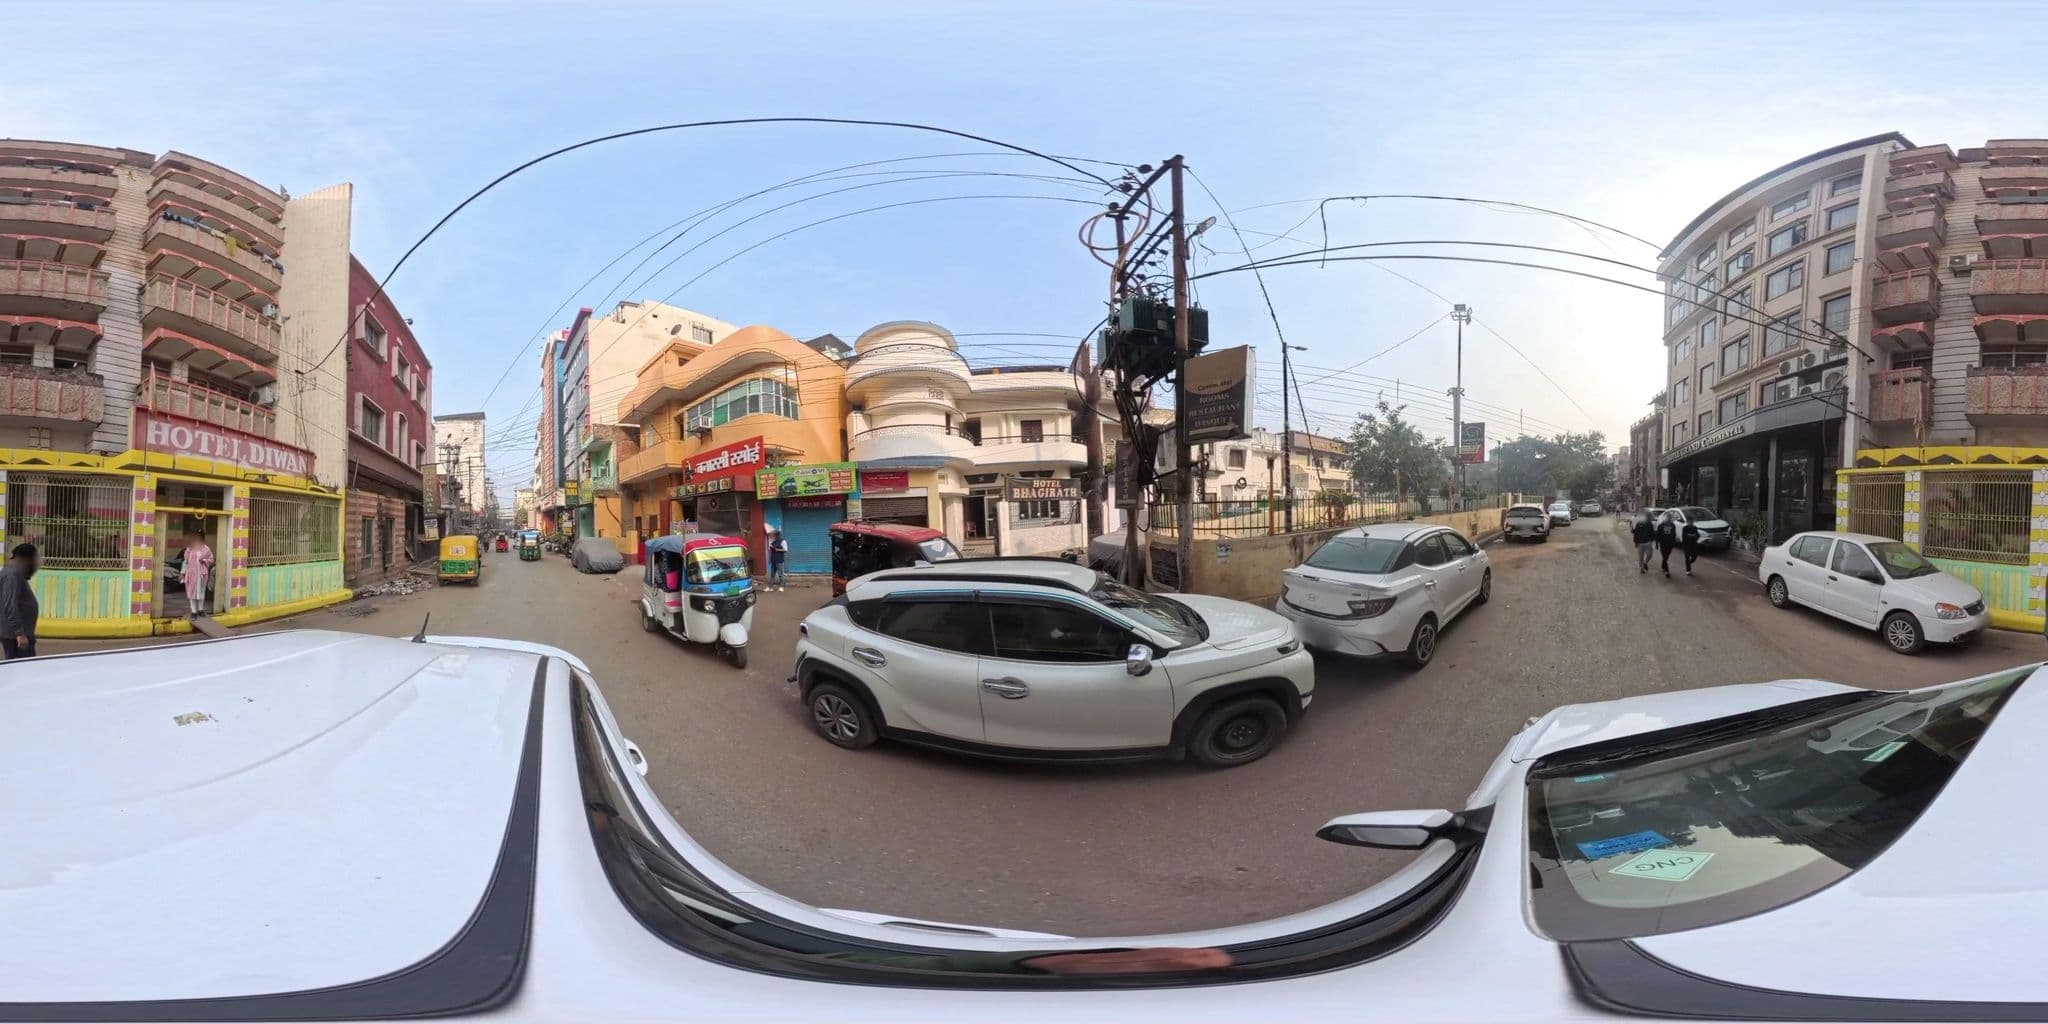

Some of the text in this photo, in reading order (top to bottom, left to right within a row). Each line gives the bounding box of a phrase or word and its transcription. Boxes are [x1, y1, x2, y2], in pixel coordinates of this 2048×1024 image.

[147, 420, 307, 474] HOTEL DIWAN
[730, 441, 760, 465] रसोई
[1033, 480, 1061, 488] HOTEL
[1013, 487, 1077, 498] BHAGIRATH
[1635, 856, 1694, 872] CNG
